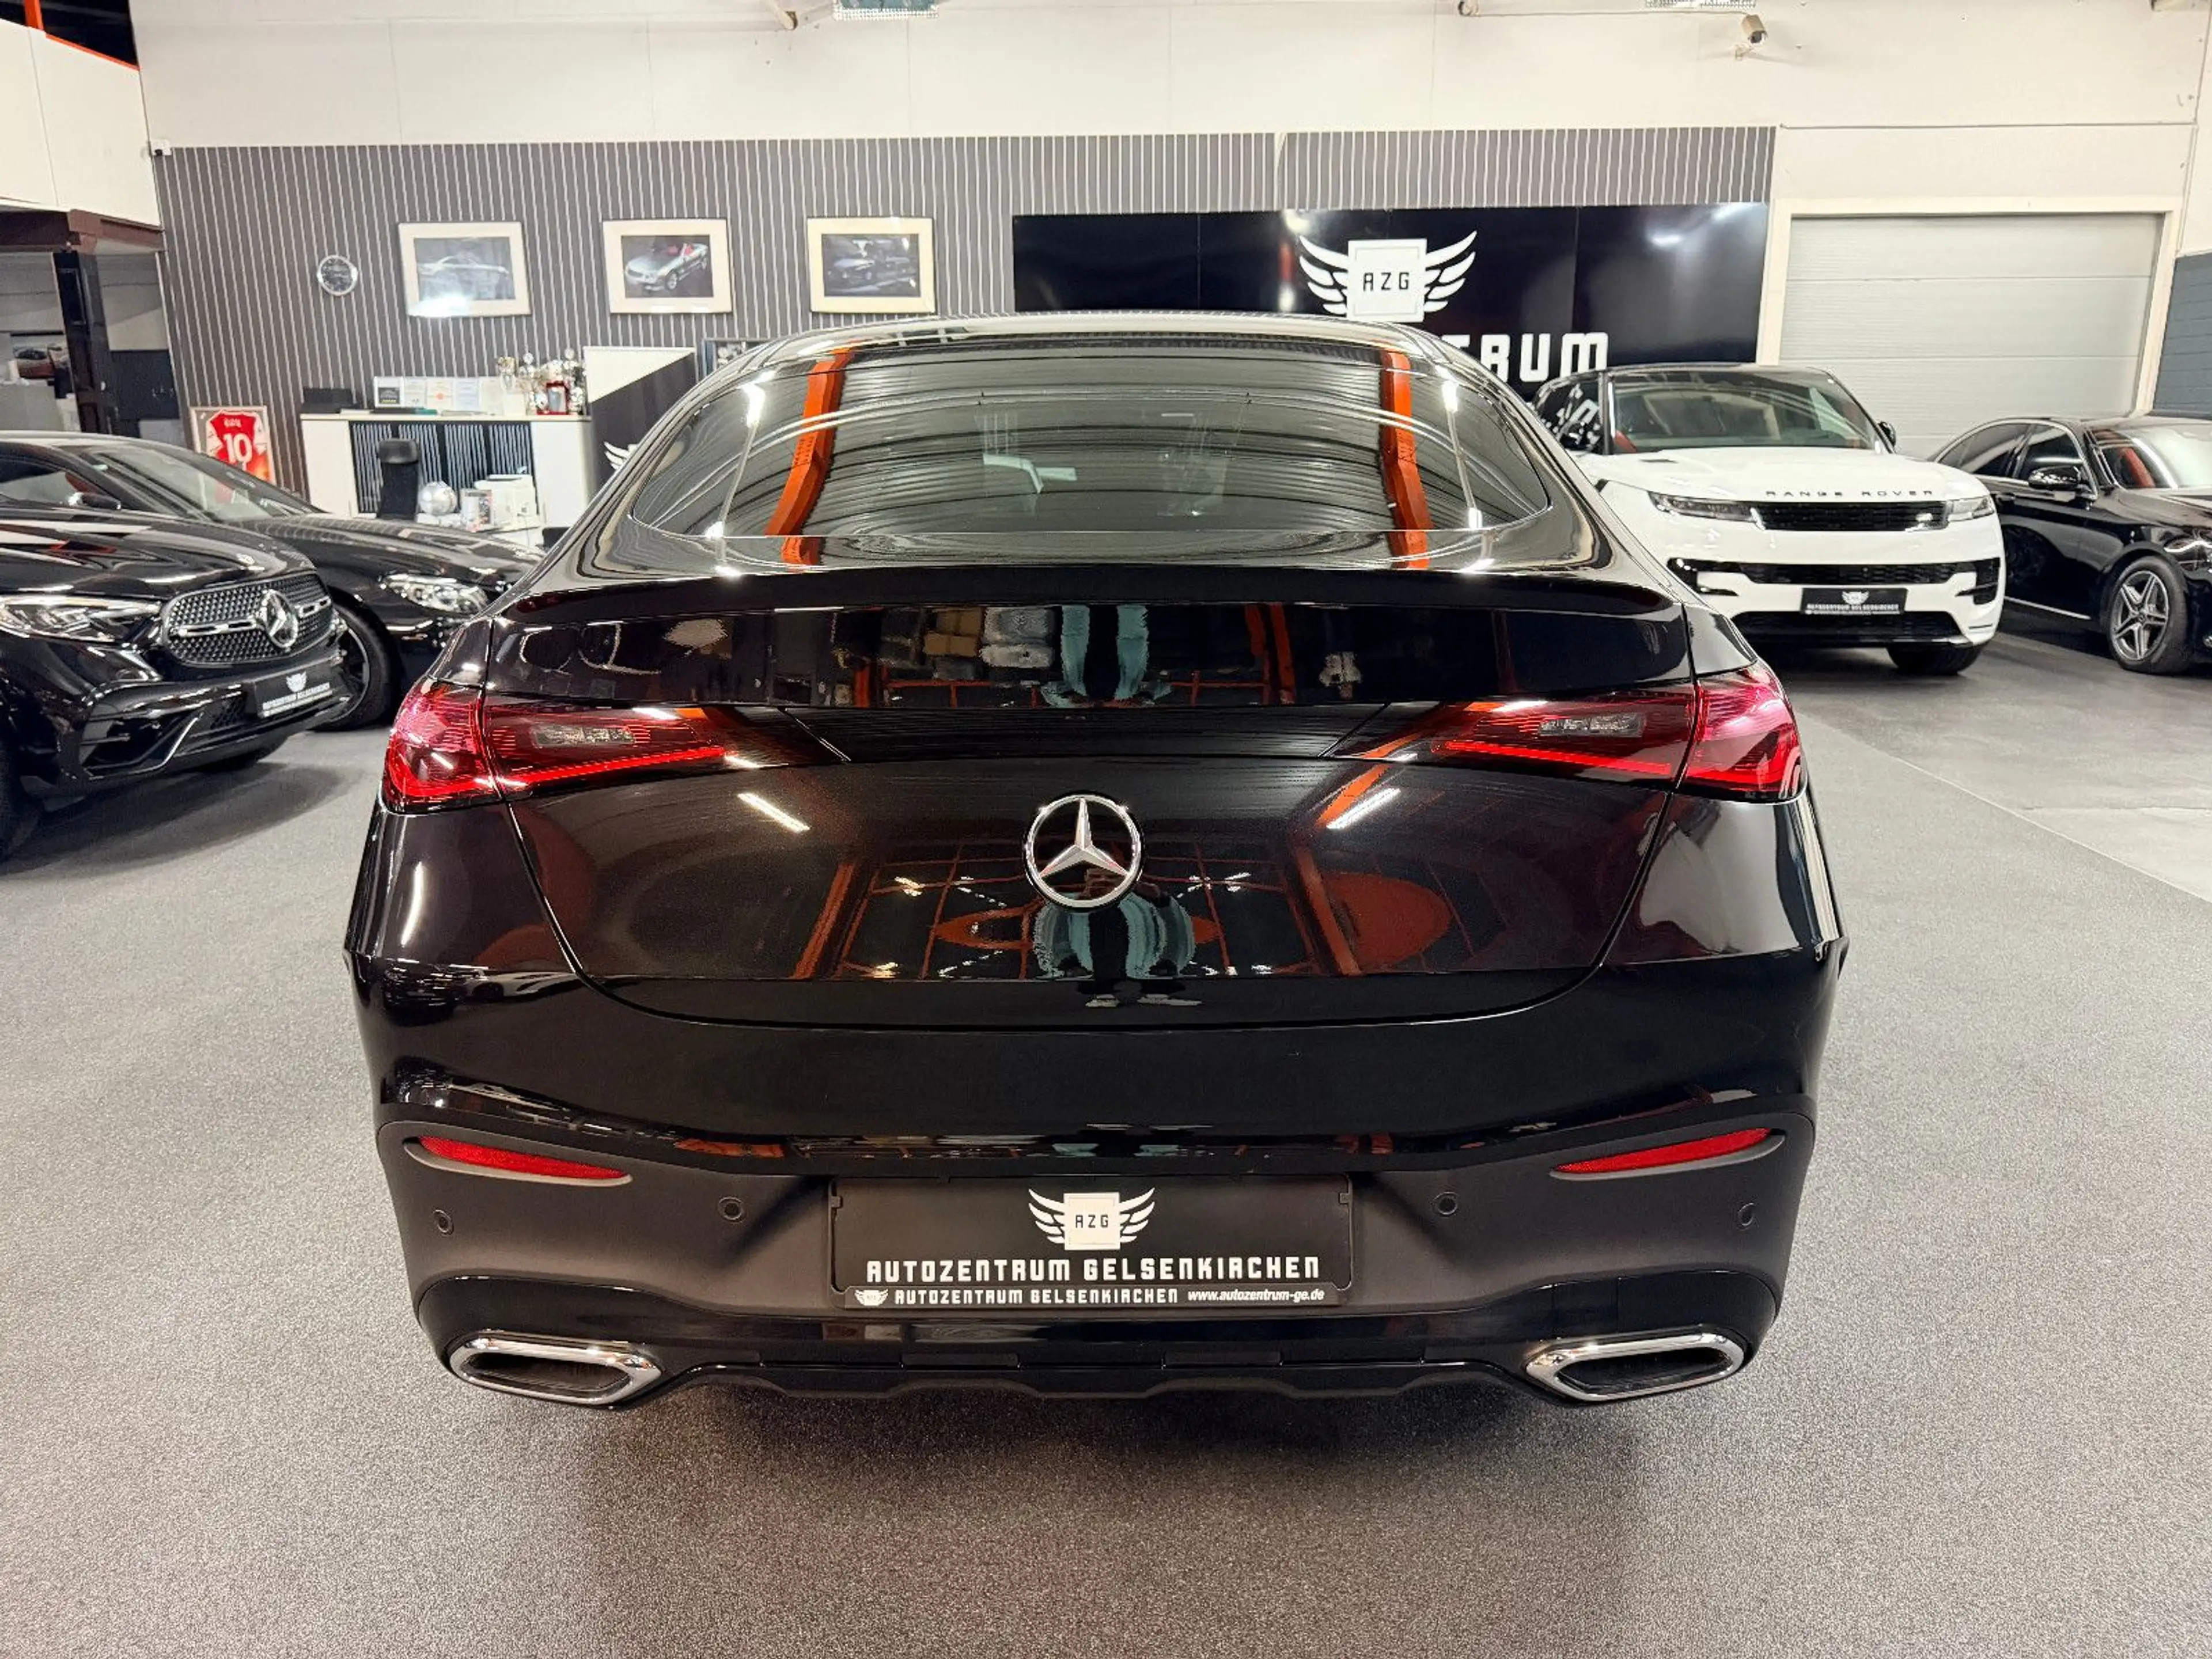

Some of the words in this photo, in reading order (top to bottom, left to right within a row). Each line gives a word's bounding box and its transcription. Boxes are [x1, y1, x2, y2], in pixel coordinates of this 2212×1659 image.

[1362, 272, 1410, 291] AZG
[224, 433, 252, 464] 10
[1075, 1214, 1109, 1228] AZG
[866, 1259, 1070, 1282] AUTOZENTRUM
[1084, 1256, 1319, 1281] GELSENKIRCHEN
[895, 1289, 1022, 1305] AUTOZENTRUM
[1031, 1288, 1178, 1304] GELSENKIRCHEN
[1188, 1287, 1325, 1303] www.autozentrum-ge.de
